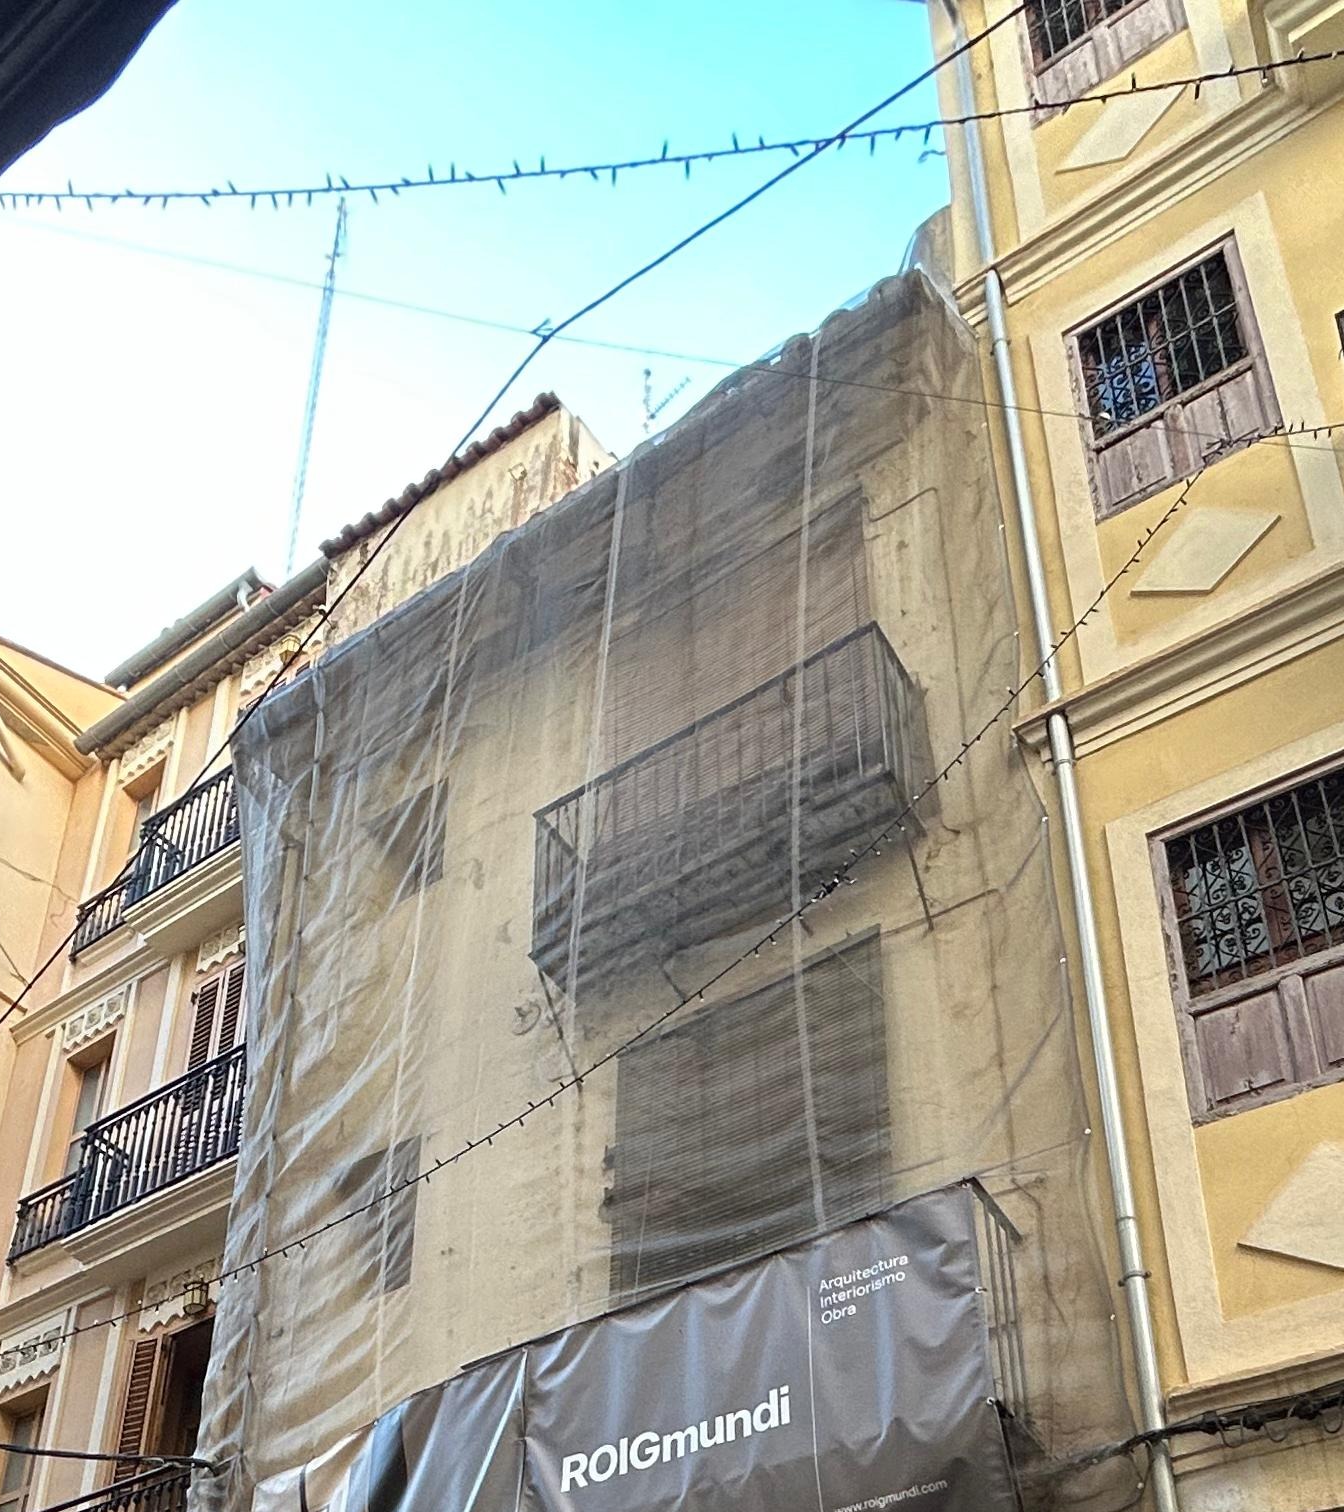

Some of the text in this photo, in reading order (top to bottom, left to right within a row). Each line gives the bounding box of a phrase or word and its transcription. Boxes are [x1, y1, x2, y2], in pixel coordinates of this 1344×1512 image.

[819, 1255, 908, 1294] Arquitectura
[820, 1271, 906, 1308] Interiorismo
[821, 1304, 856, 1324] Obra
[560, 1384, 791, 1493] ROIGmundi
